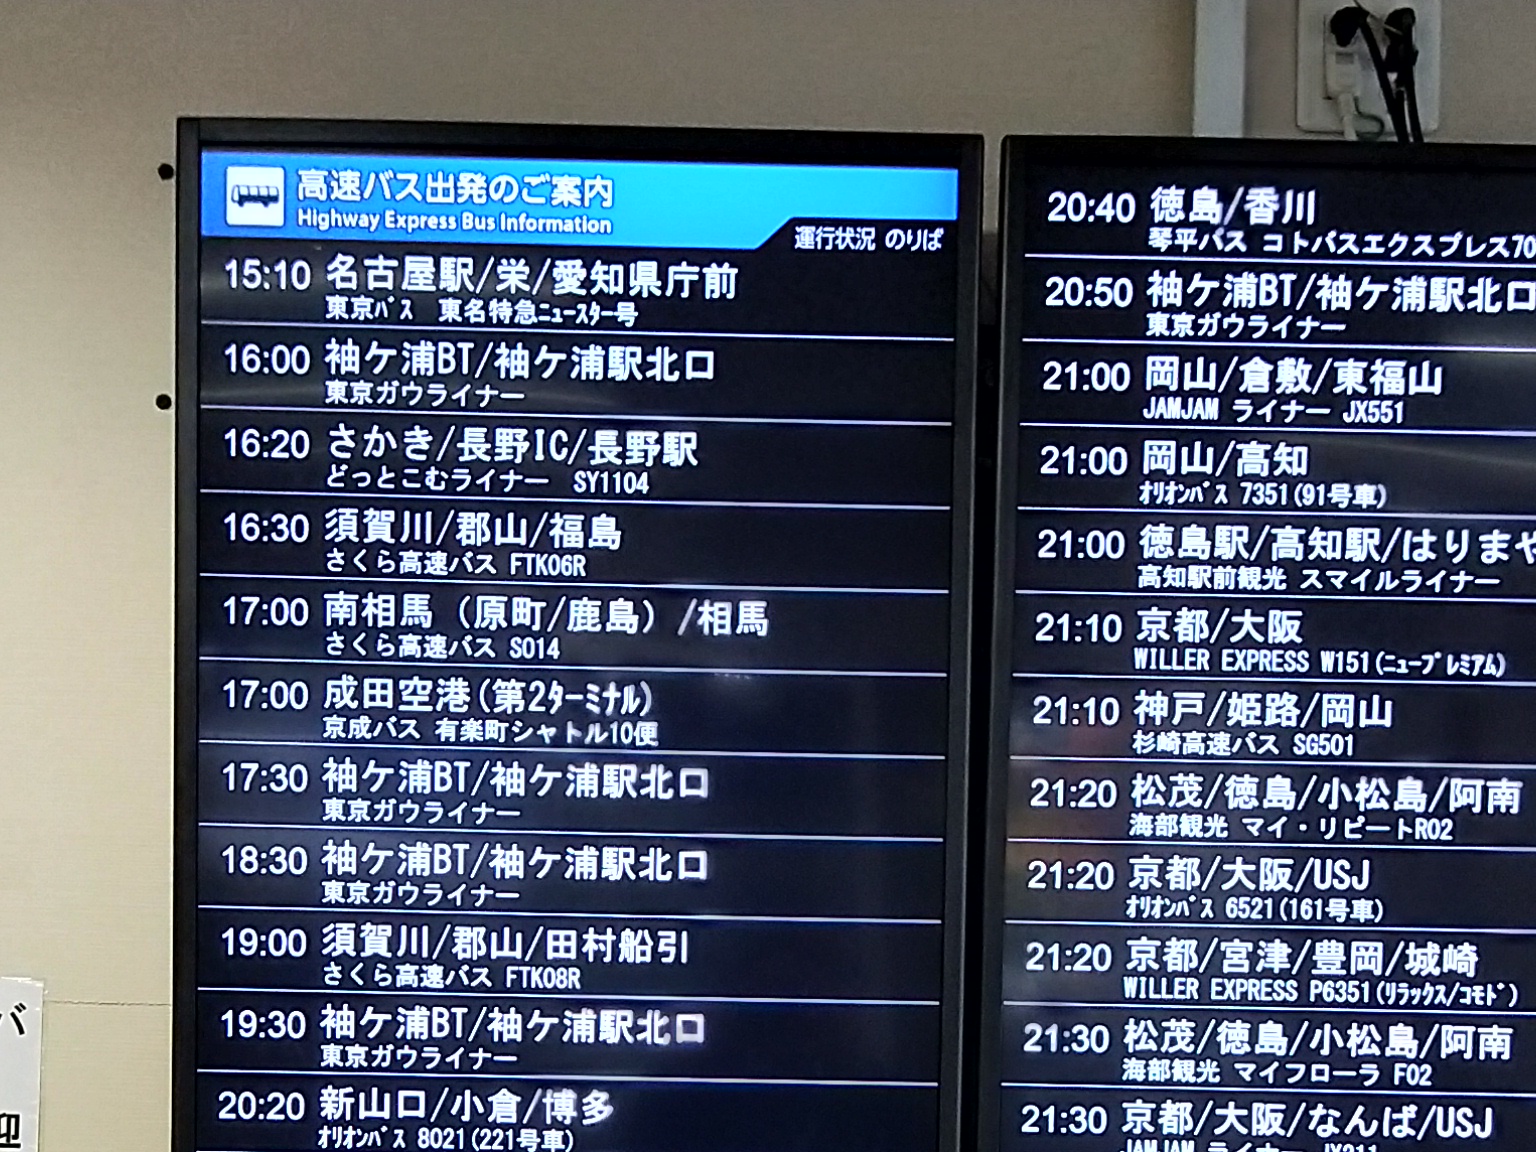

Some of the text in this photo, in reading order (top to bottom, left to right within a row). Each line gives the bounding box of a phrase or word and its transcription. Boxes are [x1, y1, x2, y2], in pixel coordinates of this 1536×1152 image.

[297, 169, 614, 208] 高速バス出発のご案内
[298, 210, 612, 235] Highway Express Bus Information
[794, 226, 944, 252] 運行状況 のりば
[224, 256, 738, 297] 15:10 名古屋駅/栄/愛知県庁前
[224, 345, 311, 374] 16:00
[1043, 356, 1442, 397] 21:00 岡山/倉敷/東福山
[325, 381, 525, 407] 東京ガウライナー
[1144, 398, 1405, 424] JAMJAM ライナー JX551
[224, 425, 698, 466] 16:20 さかき/長野IC/長野駅
[325, 466, 650, 494] どっとこむライナー SY1104
[224, 508, 622, 550] 16:30 須賀川/郡山/福島
[1038, 529, 1125, 560] 21:00
[325, 550, 587, 577] さくら高速バス FTK06R
[1138, 565, 1501, 593] 高知駅前観光 スマイルライナー
[1033, 691, 1393, 730] 21:10 神戸/姫路/岡山
[1133, 731, 1354, 757] 杉崎高速バス SG501
[1028, 857, 1371, 892] 21:20 京都/大阪/USJ
